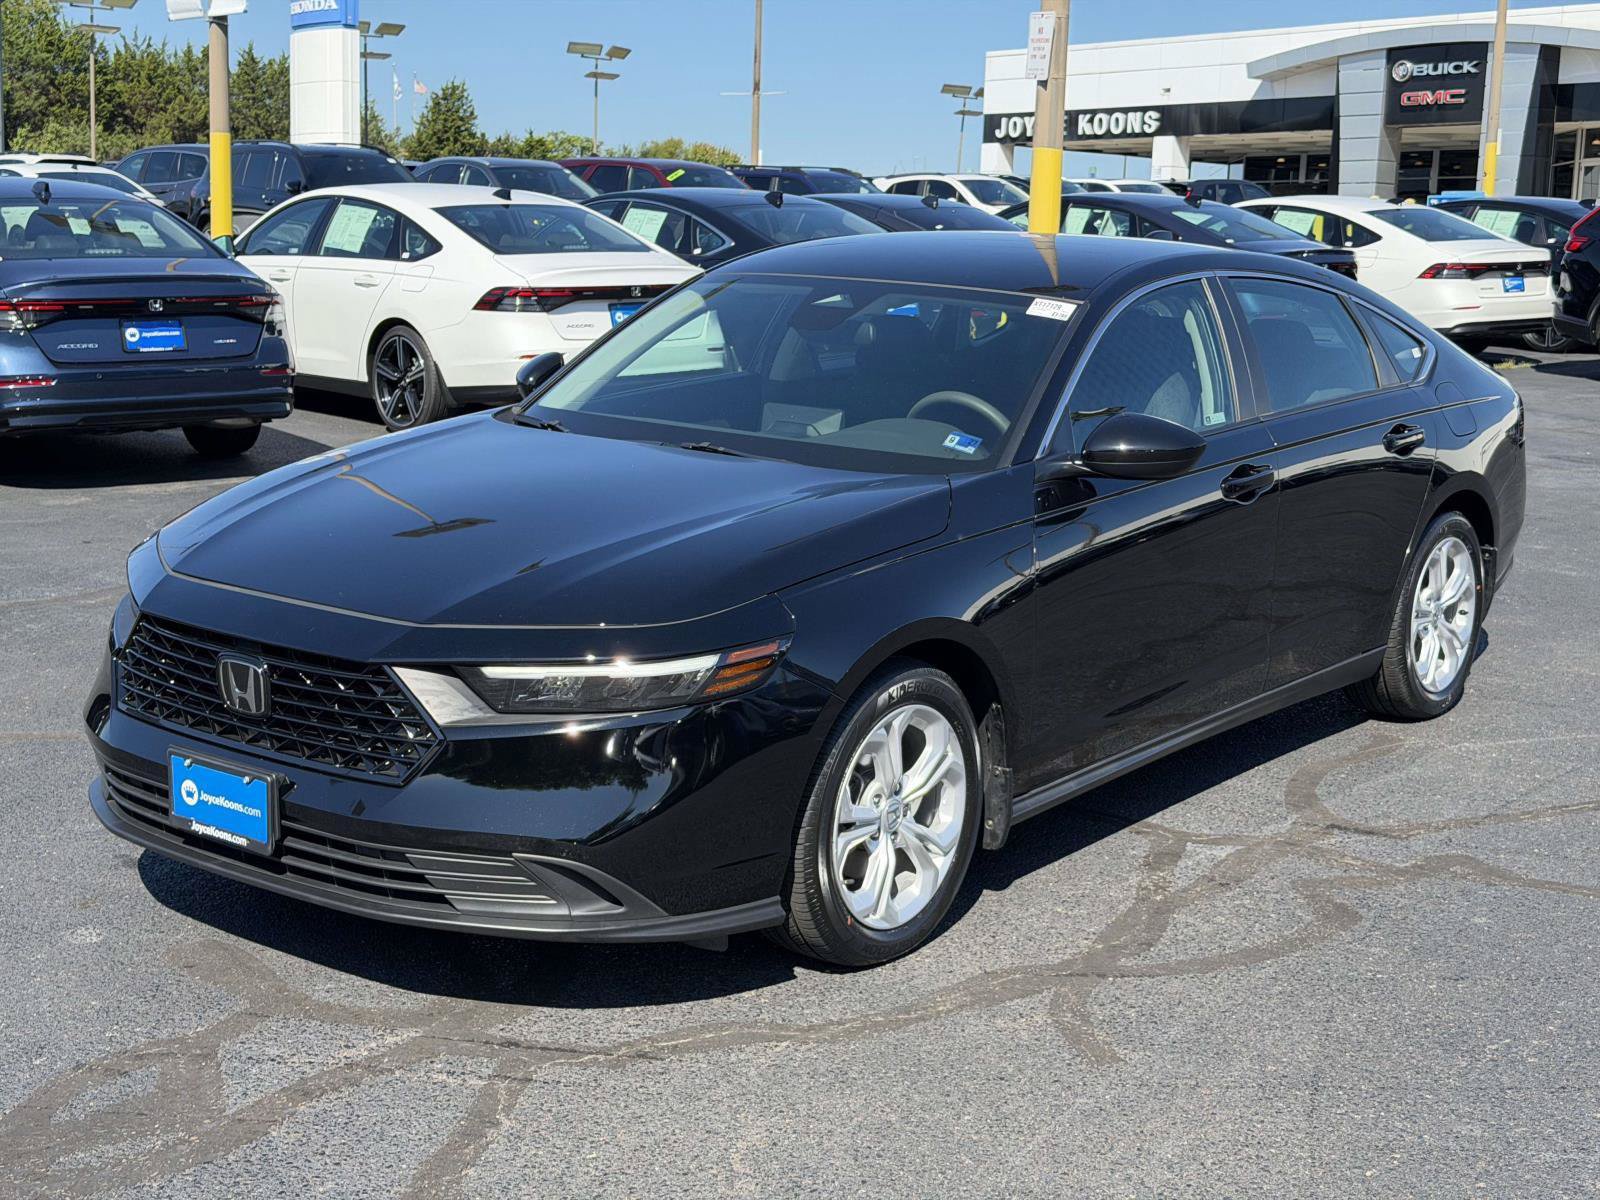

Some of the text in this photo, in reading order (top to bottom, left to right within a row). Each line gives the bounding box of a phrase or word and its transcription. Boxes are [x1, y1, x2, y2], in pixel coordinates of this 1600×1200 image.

[1412, 61, 1480, 76] BUICK
[1401, 89, 1466, 106] GMC
[994, 110, 1161, 139] JOY KOONS
[200, 790, 262, 818] JoyceKoons.com
[191, 819, 247, 846] JoyceKoons.com
